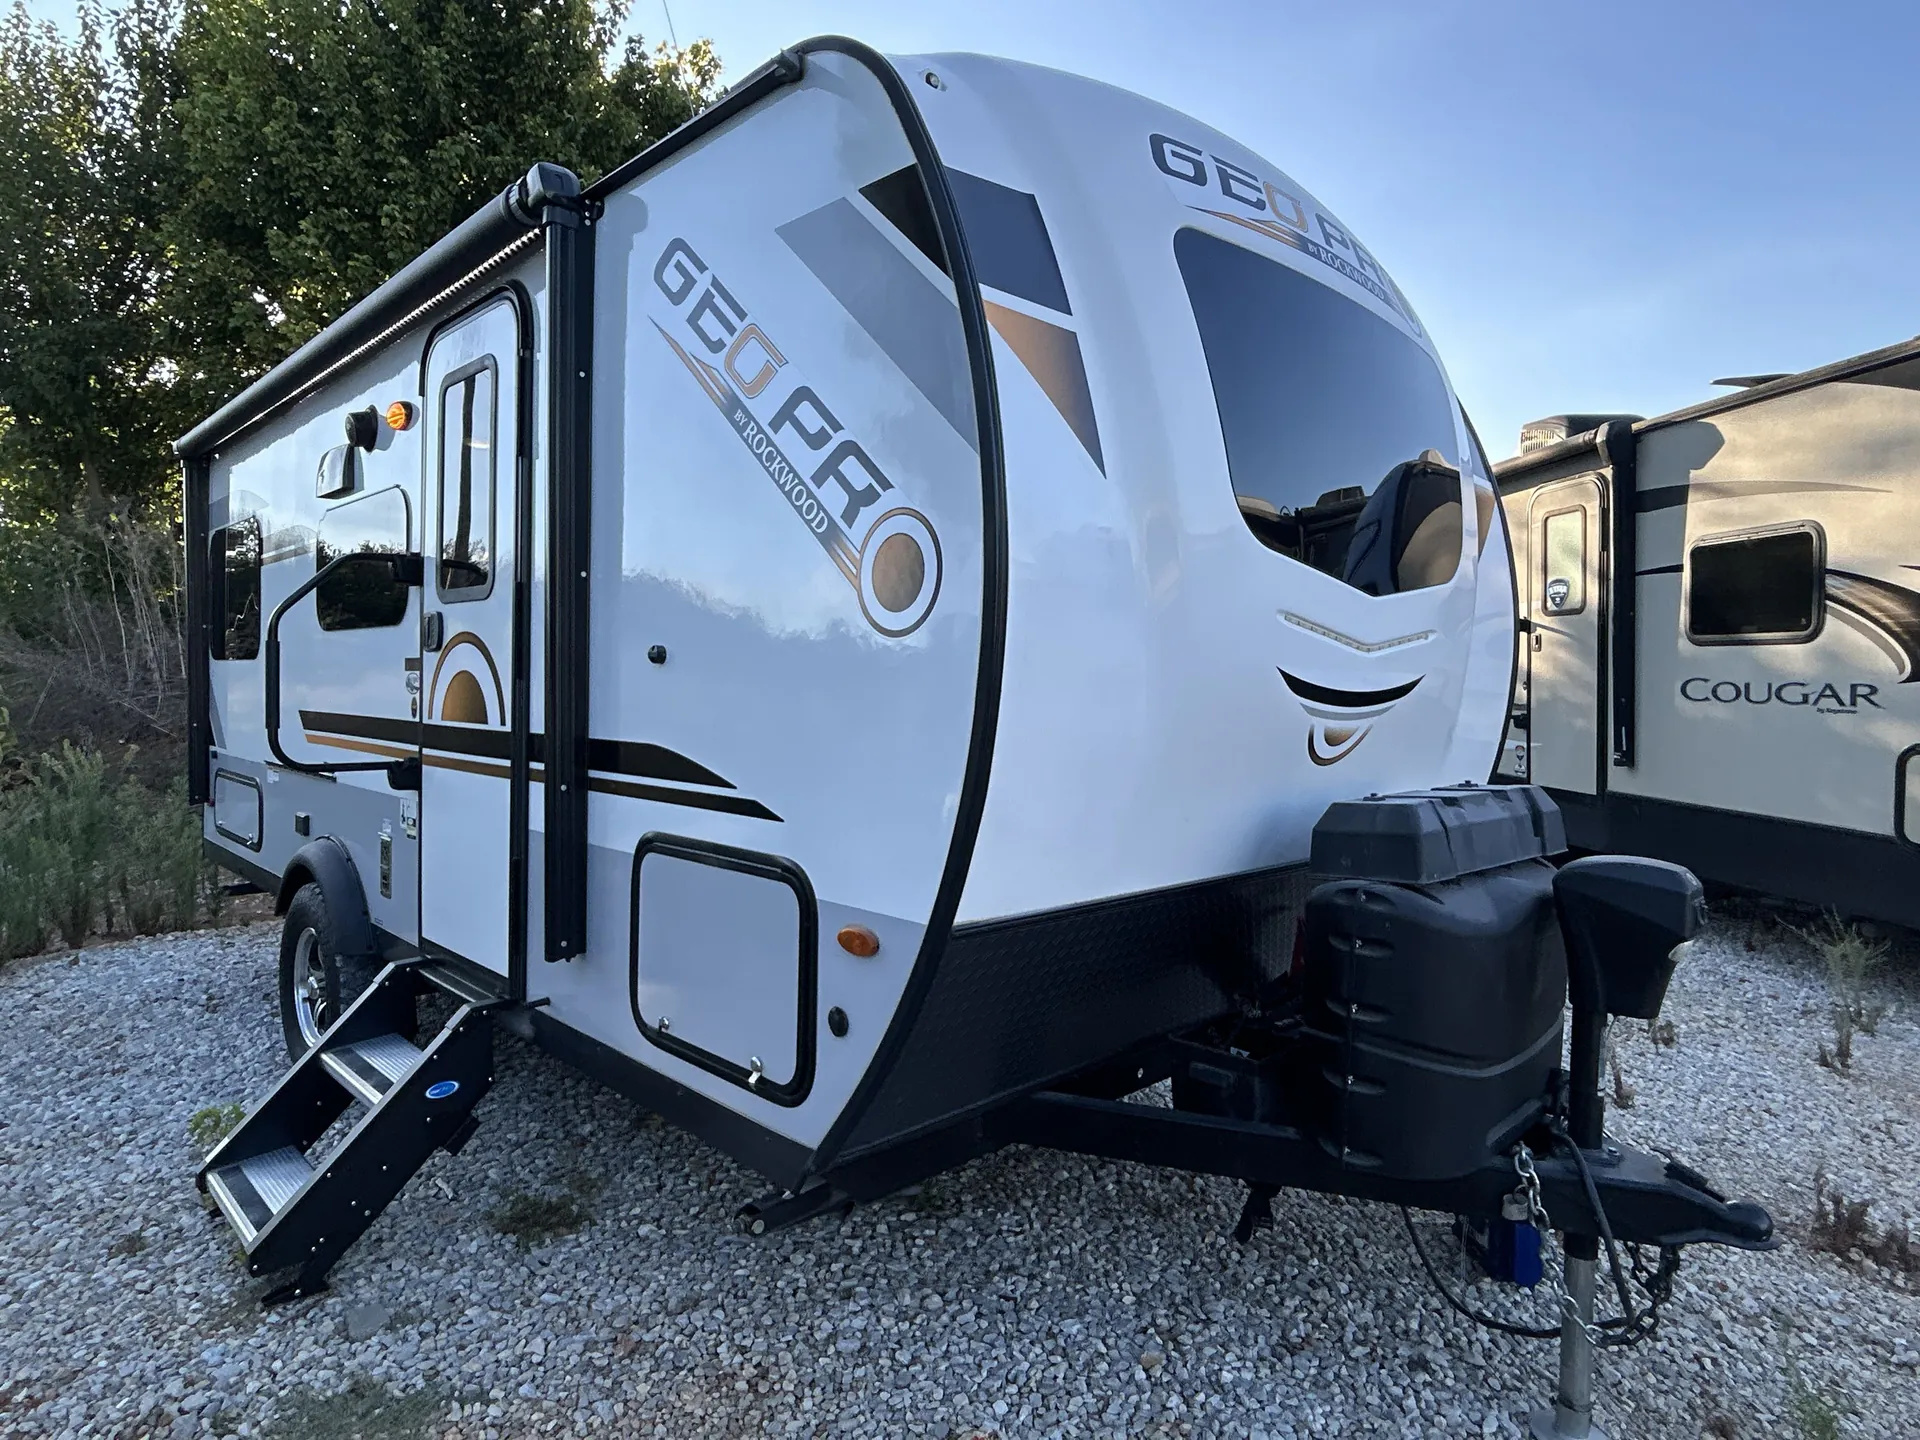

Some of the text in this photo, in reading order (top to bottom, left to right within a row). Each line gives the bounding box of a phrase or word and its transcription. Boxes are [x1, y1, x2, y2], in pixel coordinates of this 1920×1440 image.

[1149, 133, 1308, 233] GEO
[653, 237, 788, 399] GEO
[1307, 242, 1385, 300] BY ROCKWOOD
[733, 408, 829, 534] BY ROCKWOOD
[1680, 677, 1886, 710] COUGAR
